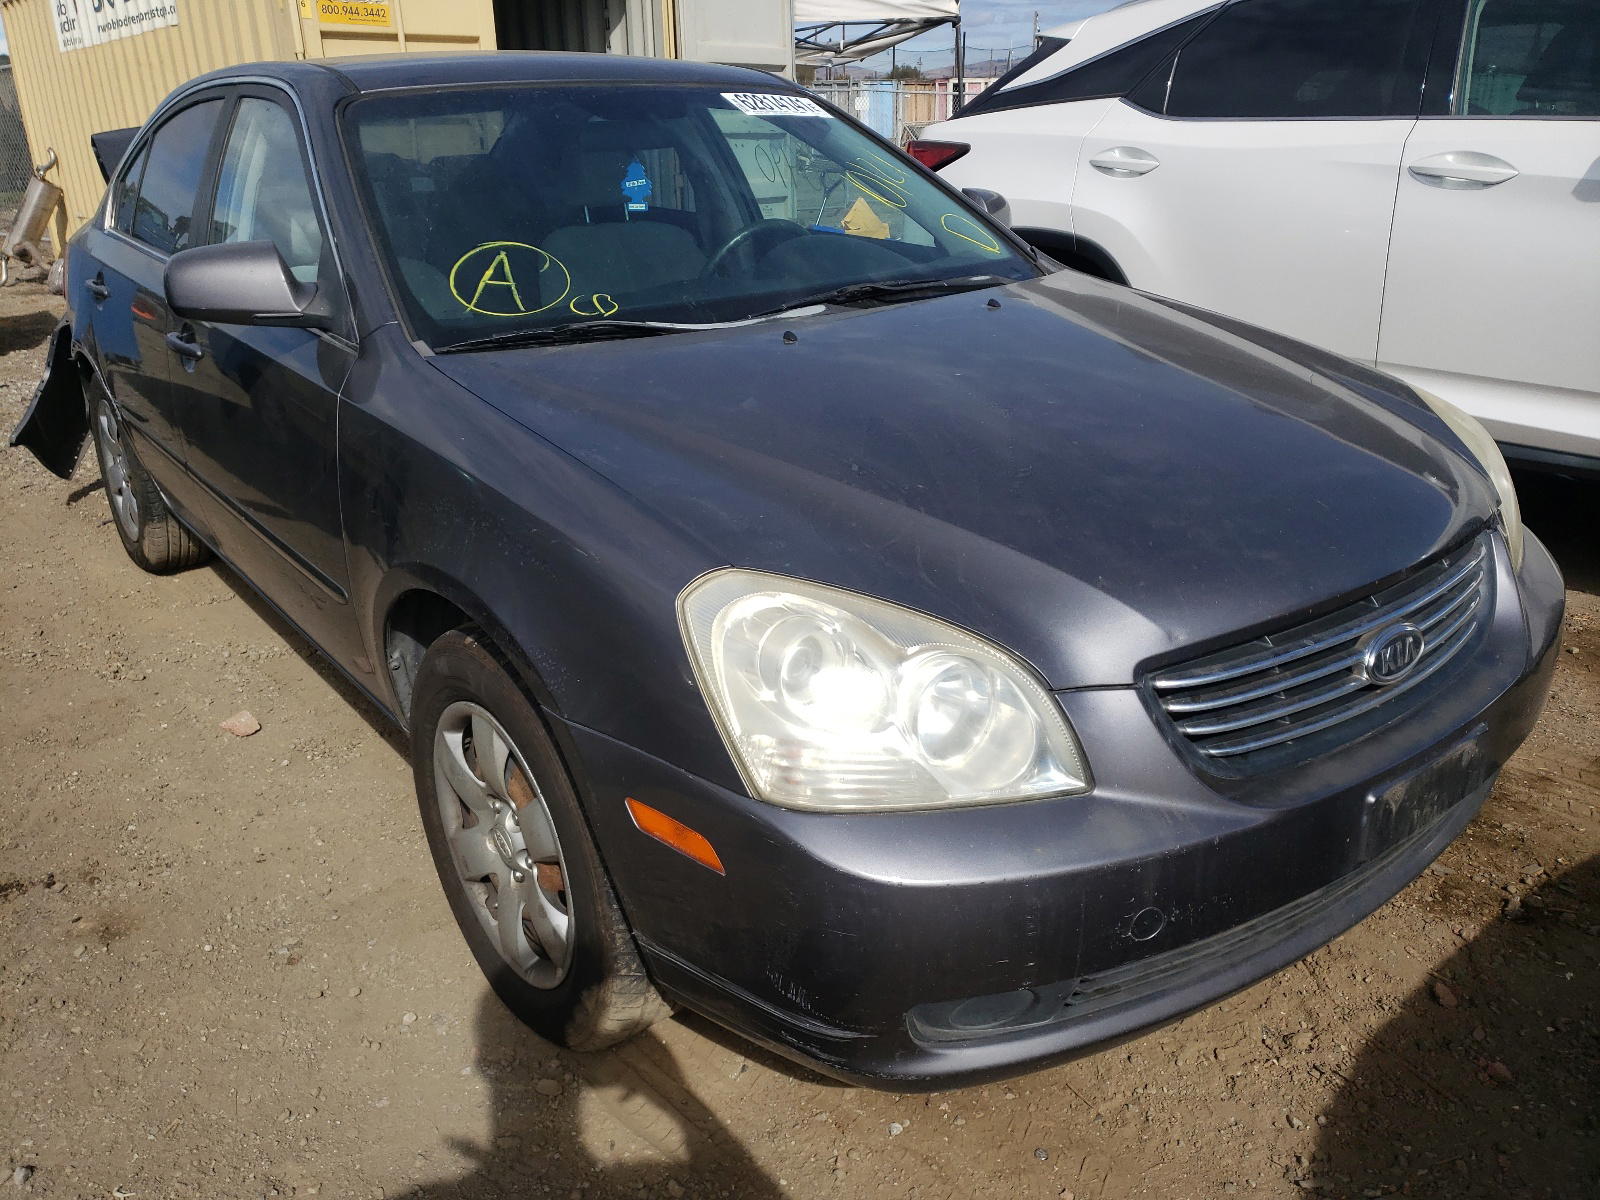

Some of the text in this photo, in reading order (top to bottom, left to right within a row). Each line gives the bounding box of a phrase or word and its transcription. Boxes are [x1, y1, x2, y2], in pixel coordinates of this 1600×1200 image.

[321, 4, 387, 19] 800.944.3442
[733, 93, 816, 112] 62814141
[1381, 636, 1418, 675] KIA
